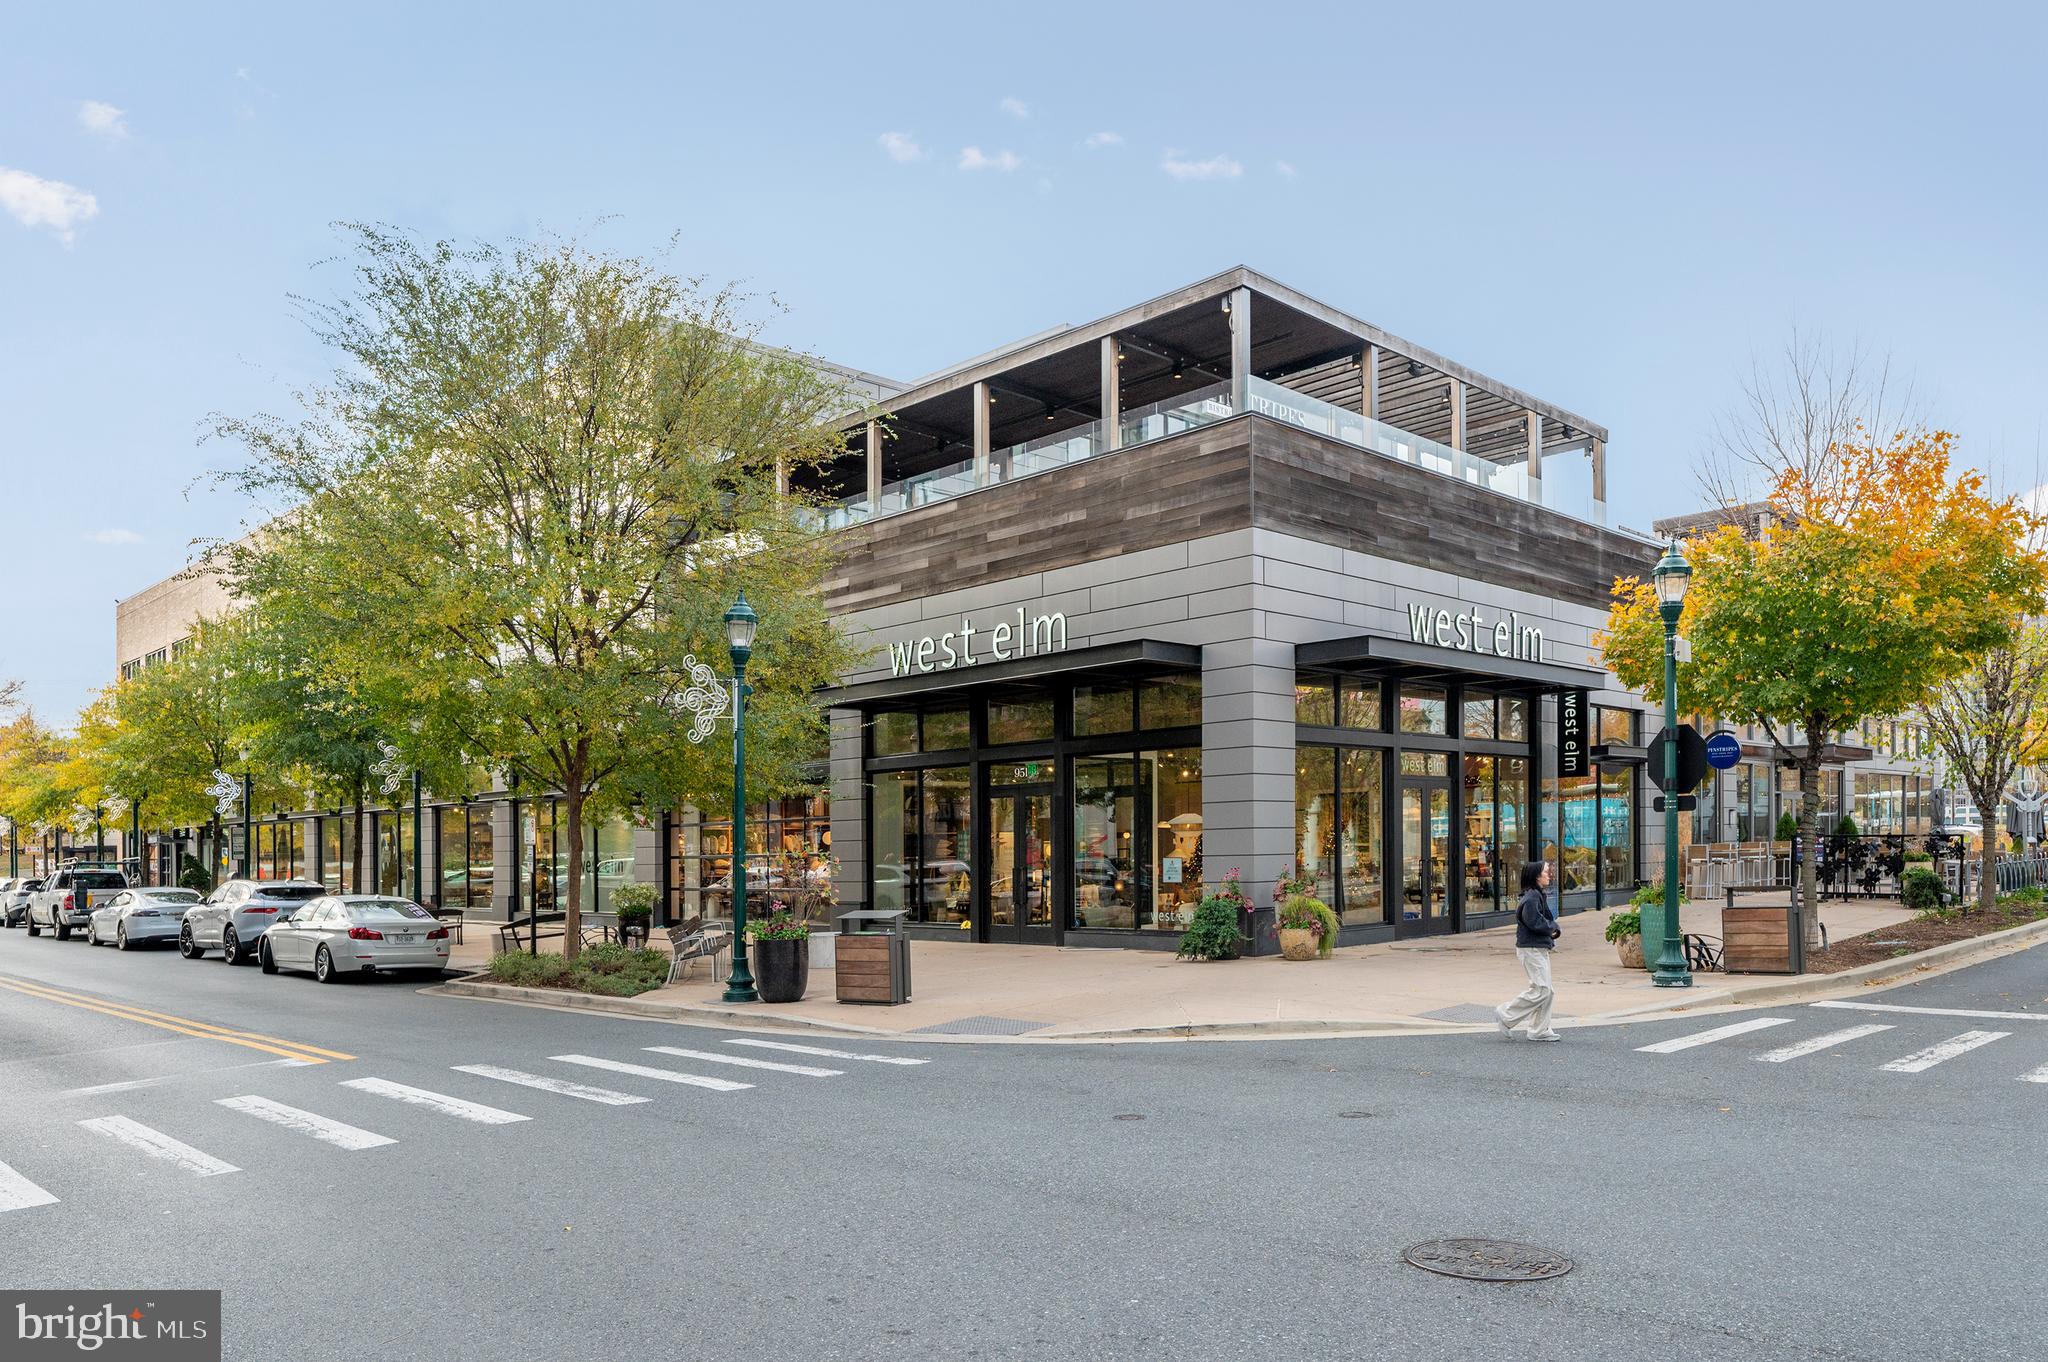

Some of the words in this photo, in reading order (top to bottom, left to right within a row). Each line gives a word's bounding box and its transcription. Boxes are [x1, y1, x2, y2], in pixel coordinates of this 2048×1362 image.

[889, 619, 977, 677] west
[992, 607, 1067, 660] elm
[1407, 602, 1483, 653] west
[1493, 612, 1543, 662] elm
[1564, 693, 1579, 736] west
[1014, 767, 1028, 778] 951
[1400, 757, 1426, 772] west
[1427, 757, 1446, 773] elm
[1564, 740, 1580, 771] elm
